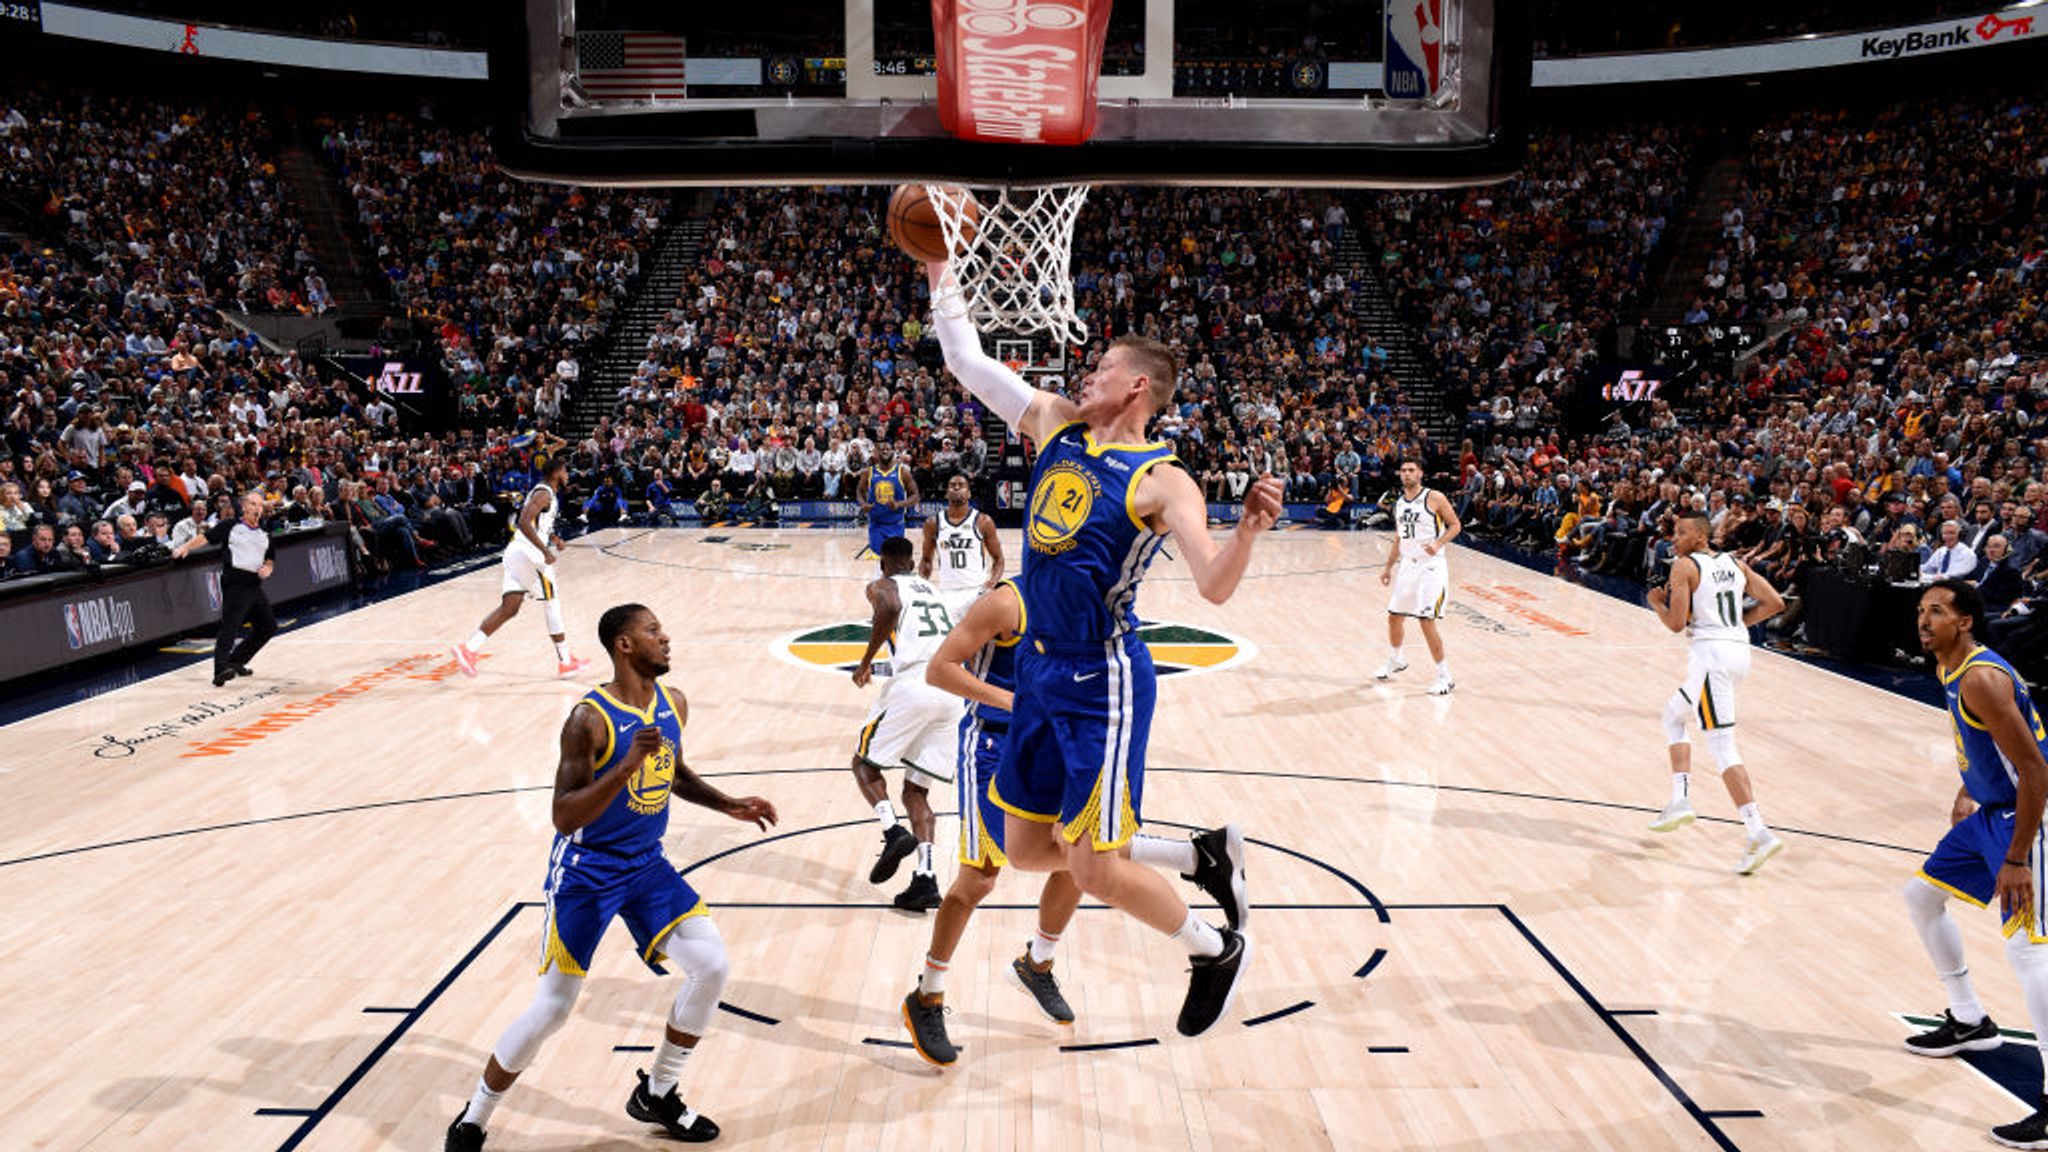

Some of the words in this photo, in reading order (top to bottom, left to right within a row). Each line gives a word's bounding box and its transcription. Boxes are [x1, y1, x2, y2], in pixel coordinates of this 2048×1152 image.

[1861, 26, 1971, 57] KeyBank
[1392, 70, 1419, 93] NBA
[1061, 489, 1083, 513] 21
[1402, 523, 1415, 539] 31
[950, 550, 966, 569] 10
[78, 597, 112, 645] NBA
[109, 596, 135, 644] App
[912, 600, 953, 637] 33
[1716, 590, 1737, 627] 11
